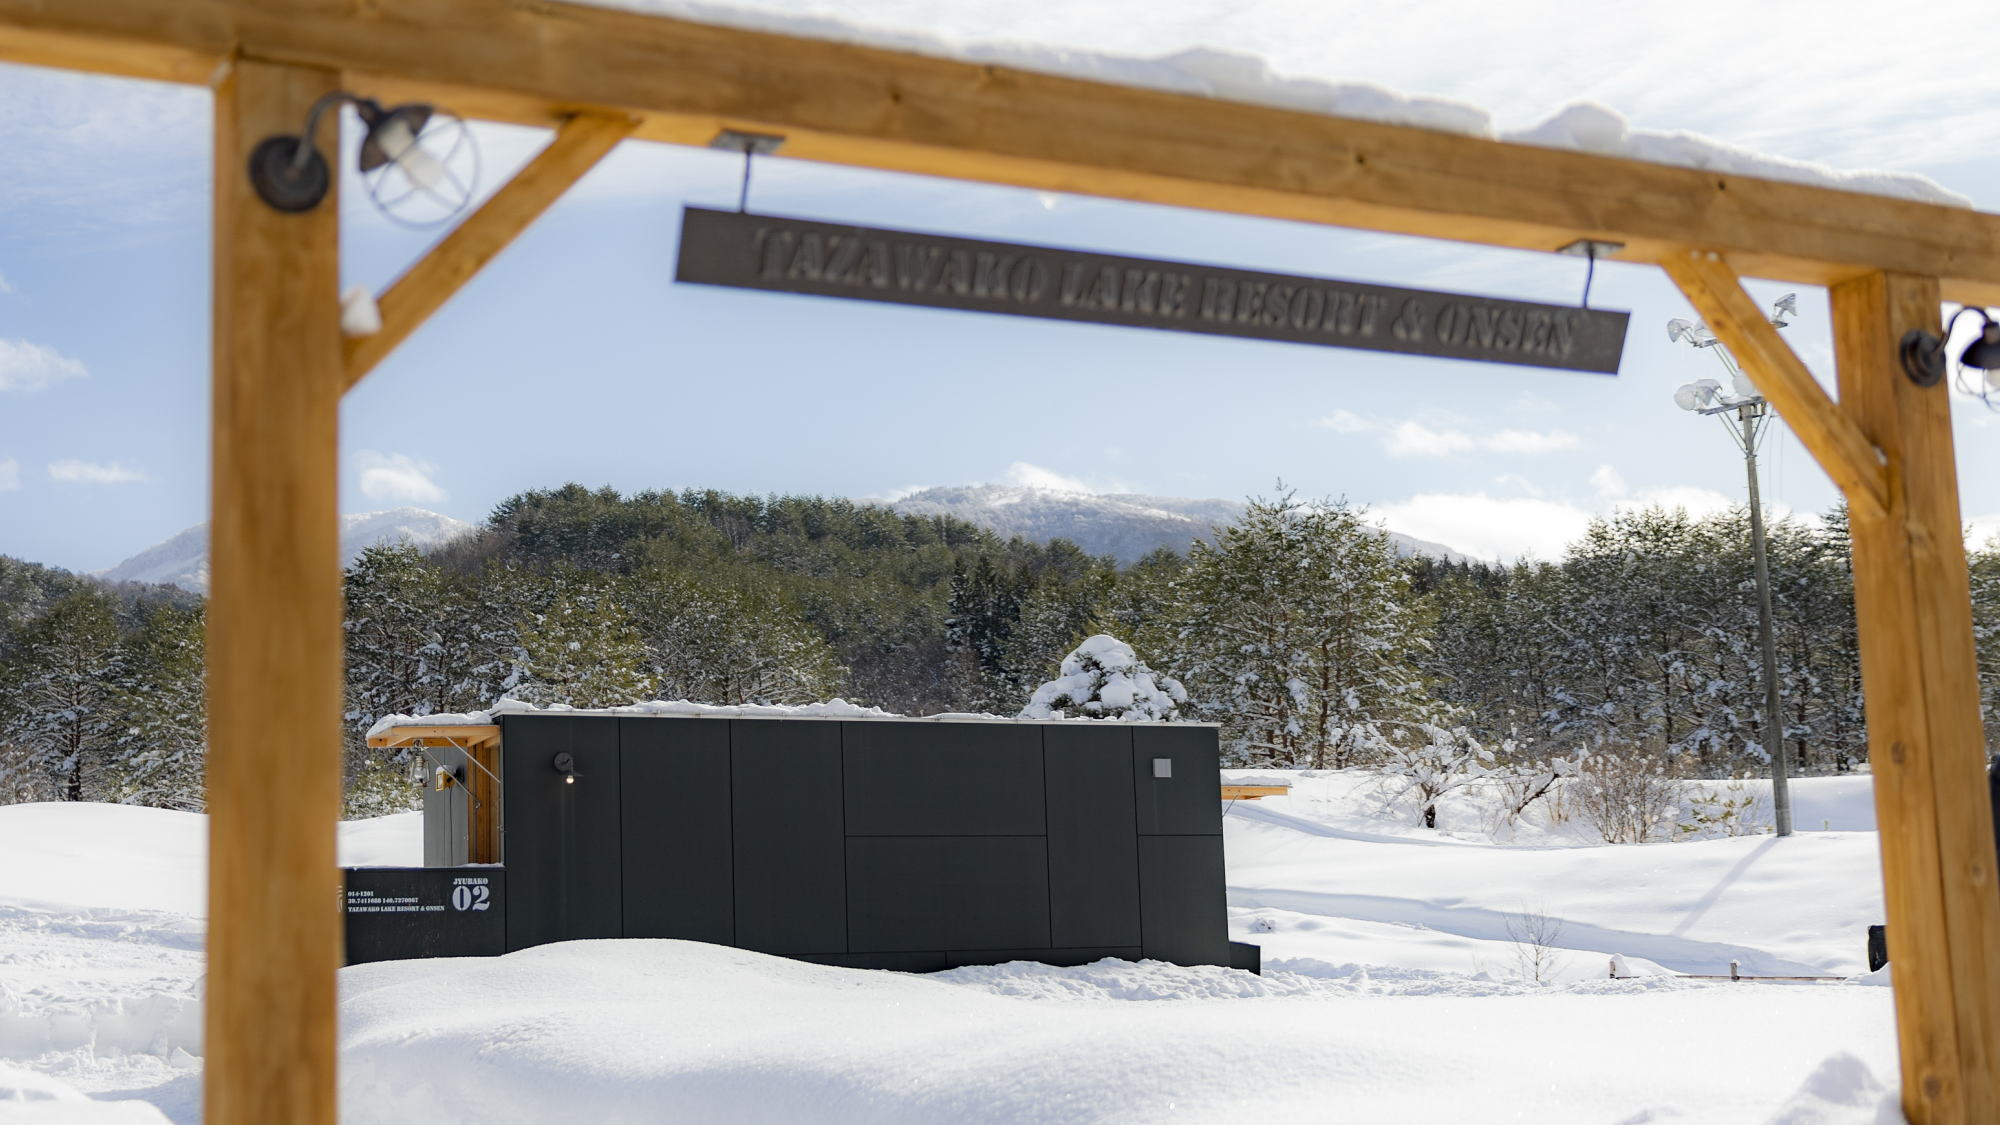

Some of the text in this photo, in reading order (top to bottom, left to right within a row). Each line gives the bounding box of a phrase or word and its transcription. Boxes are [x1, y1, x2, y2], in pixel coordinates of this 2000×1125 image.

[753, 226, 1581, 361] TAZAWAKO LAKE RESORT & ONSEN
[452, 885, 490, 911] 02
